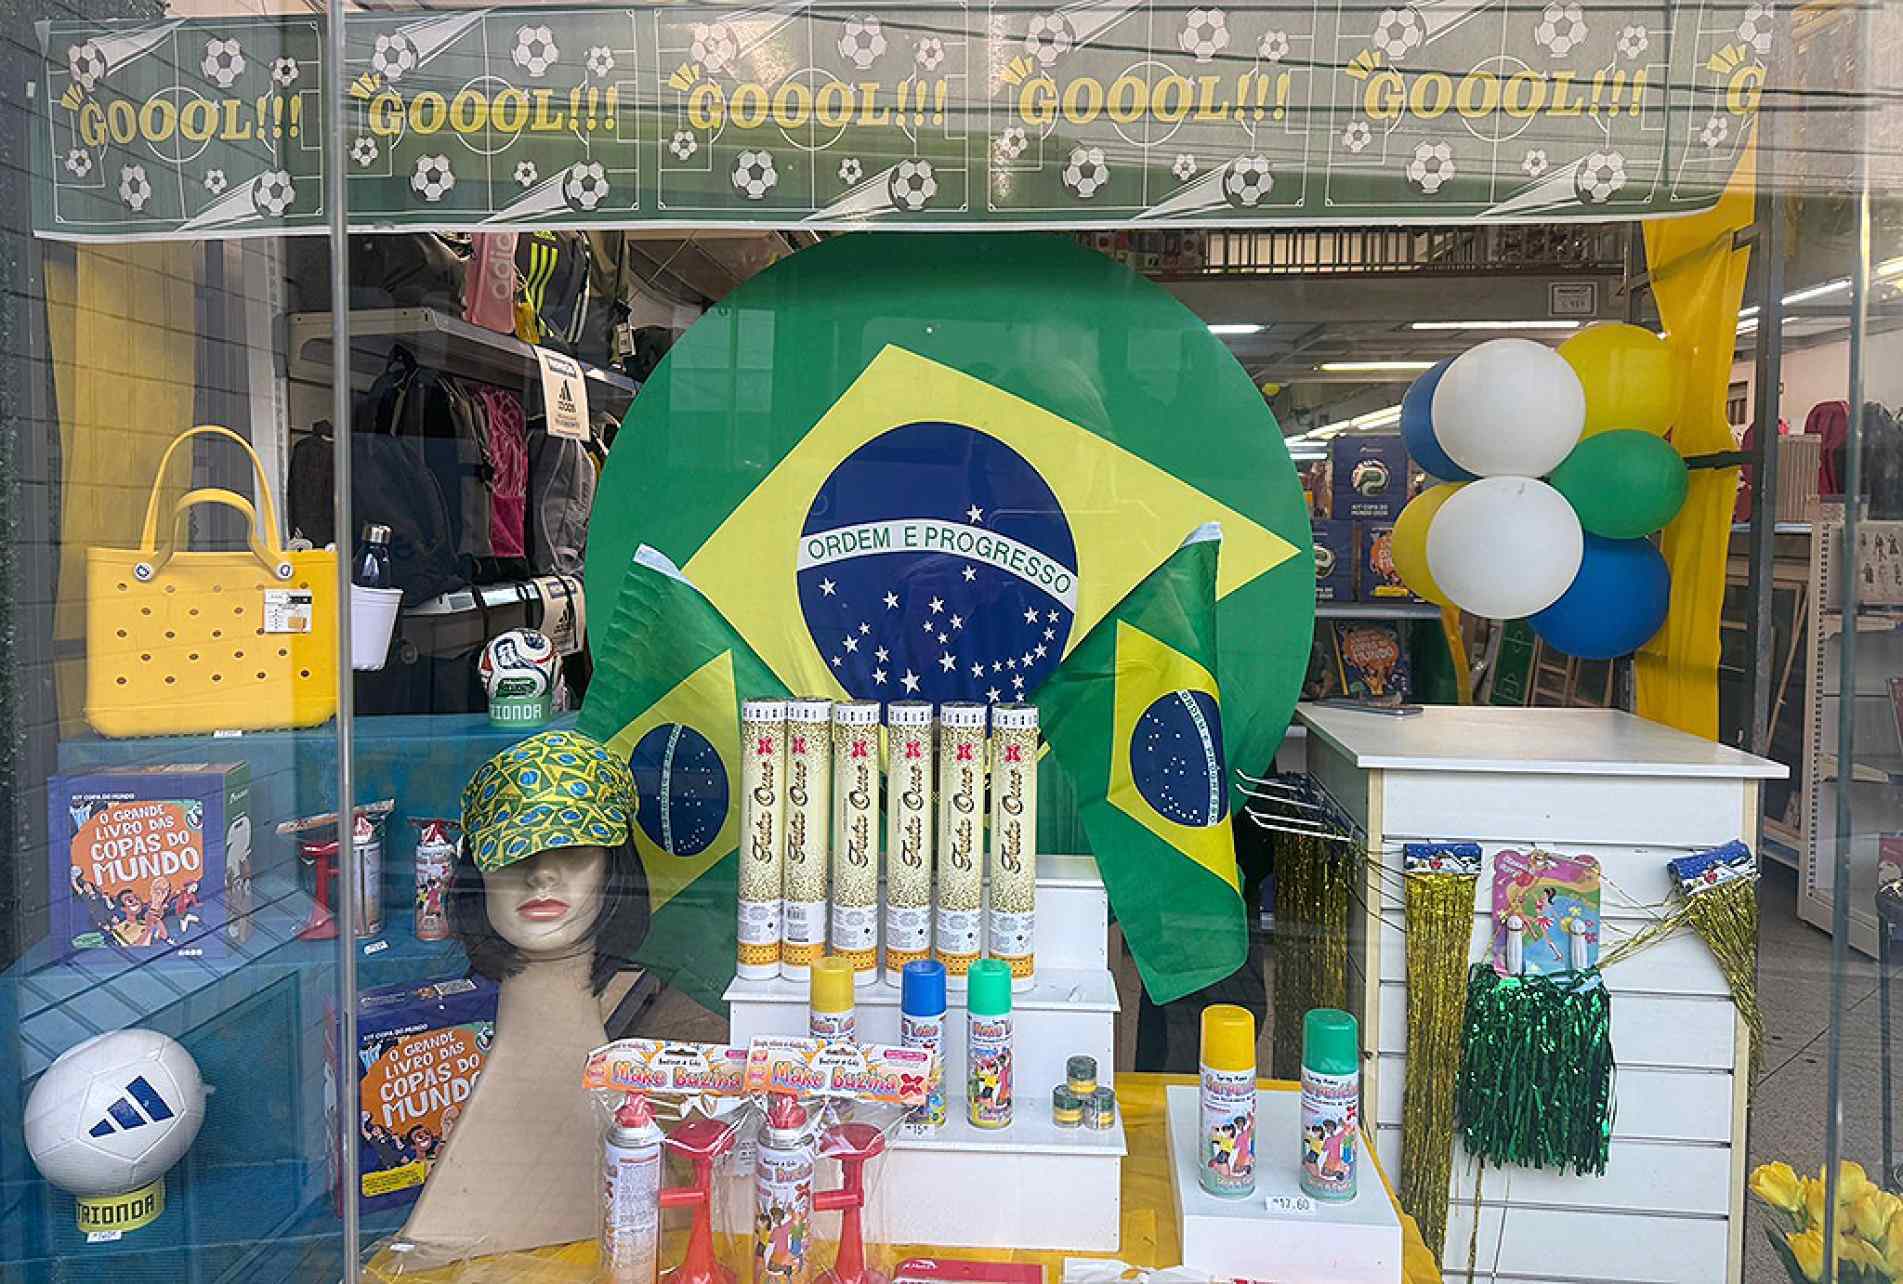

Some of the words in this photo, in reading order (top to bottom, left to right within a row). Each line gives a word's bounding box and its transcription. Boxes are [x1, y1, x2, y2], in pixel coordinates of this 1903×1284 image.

[369, 86, 617, 137] GOOOL!!!
[688, 79, 946, 129] GOOOL!!!
[1018, 73, 1291, 125] GOOOL!!!
[1365, 69, 1646, 119] GOOOL!!!
[81, 96, 302, 147] GOOOL!!!
[807, 527, 891, 560] ORDEM
[904, 525, 917, 547] E
[924, 527, 1071, 594] PROGRESSO
[95, 821, 142, 840] LIVRO
[149, 816, 175, 831] DAS
[100, 814, 109, 825] O
[113, 804, 165, 822] GRANDE
[91, 834, 161, 861] COPAS
[167, 830, 190, 847] DO
[92, 846, 200, 886] MUNDO
[385, 1052, 434, 1079] LIVRO
[439, 1042, 465, 1060] DAS
[389, 1049, 399, 1061] O
[404, 1031, 455, 1056] GRANDE
[380, 1062, 452, 1101] COPAS
[457, 1053, 480, 1072] DO
